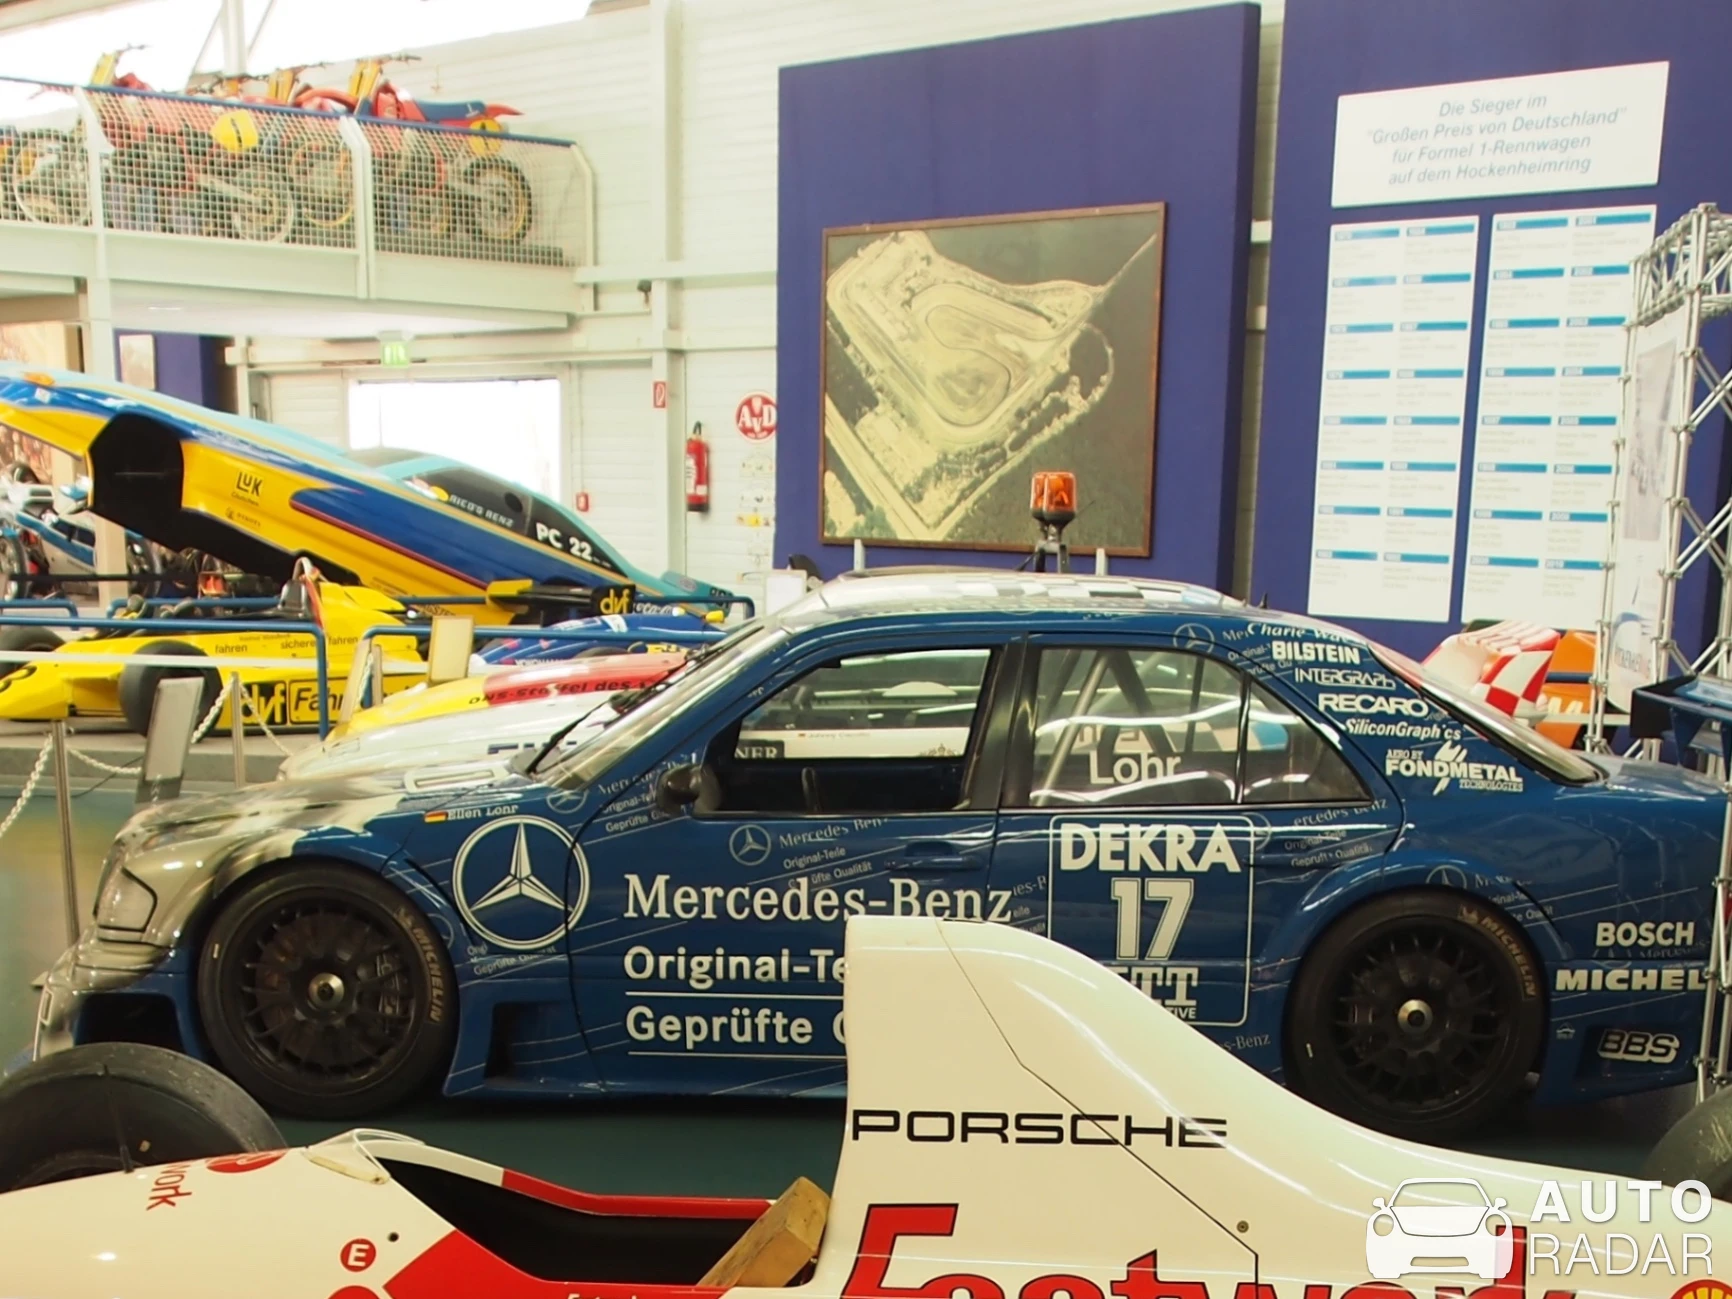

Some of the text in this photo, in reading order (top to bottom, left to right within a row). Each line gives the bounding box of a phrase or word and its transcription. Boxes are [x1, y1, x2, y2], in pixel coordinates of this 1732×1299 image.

[1438, 94, 1548, 118] Die Sieger im
[1433, 122, 1473, 140] Preis
[1479, 119, 1507, 135] von
[1417, 142, 1474, 162] Formel
[1479, 135, 1592, 156] 1-Rennwagen
[1388, 155, 1593, 186] auf dem Hockenheimring
[535, 521, 592, 561] PC 22
[215, 644, 248, 654] fahren
[328, 636, 358, 645] fahren
[1272, 641, 1361, 665] BILSTEIN
[1318, 693, 1429, 717] RECARO
[1386, 748, 1424, 760] AERO BY
[1088, 751, 1182, 785] Lohr
[1385, 759, 1524, 783] FONDMETAL
[1060, 822, 1242, 874] DEKRA
[833, 860, 873, 879] Qualität
[623, 873, 1013, 923] Mercedes-Benz
[1110, 877, 1195, 961] 17
[1595, 921, 1696, 947] BOSCH
[1480, 916, 1538, 997] MICHELIN
[413, 928, 444, 1023] MICHELIN
[625, 1004, 814, 1050] Geprüfte
[1598, 1029, 1681, 1064] BBS
[852, 1109, 1228, 1148] PORSCHE
[347, 1243, 370, 1267] E
